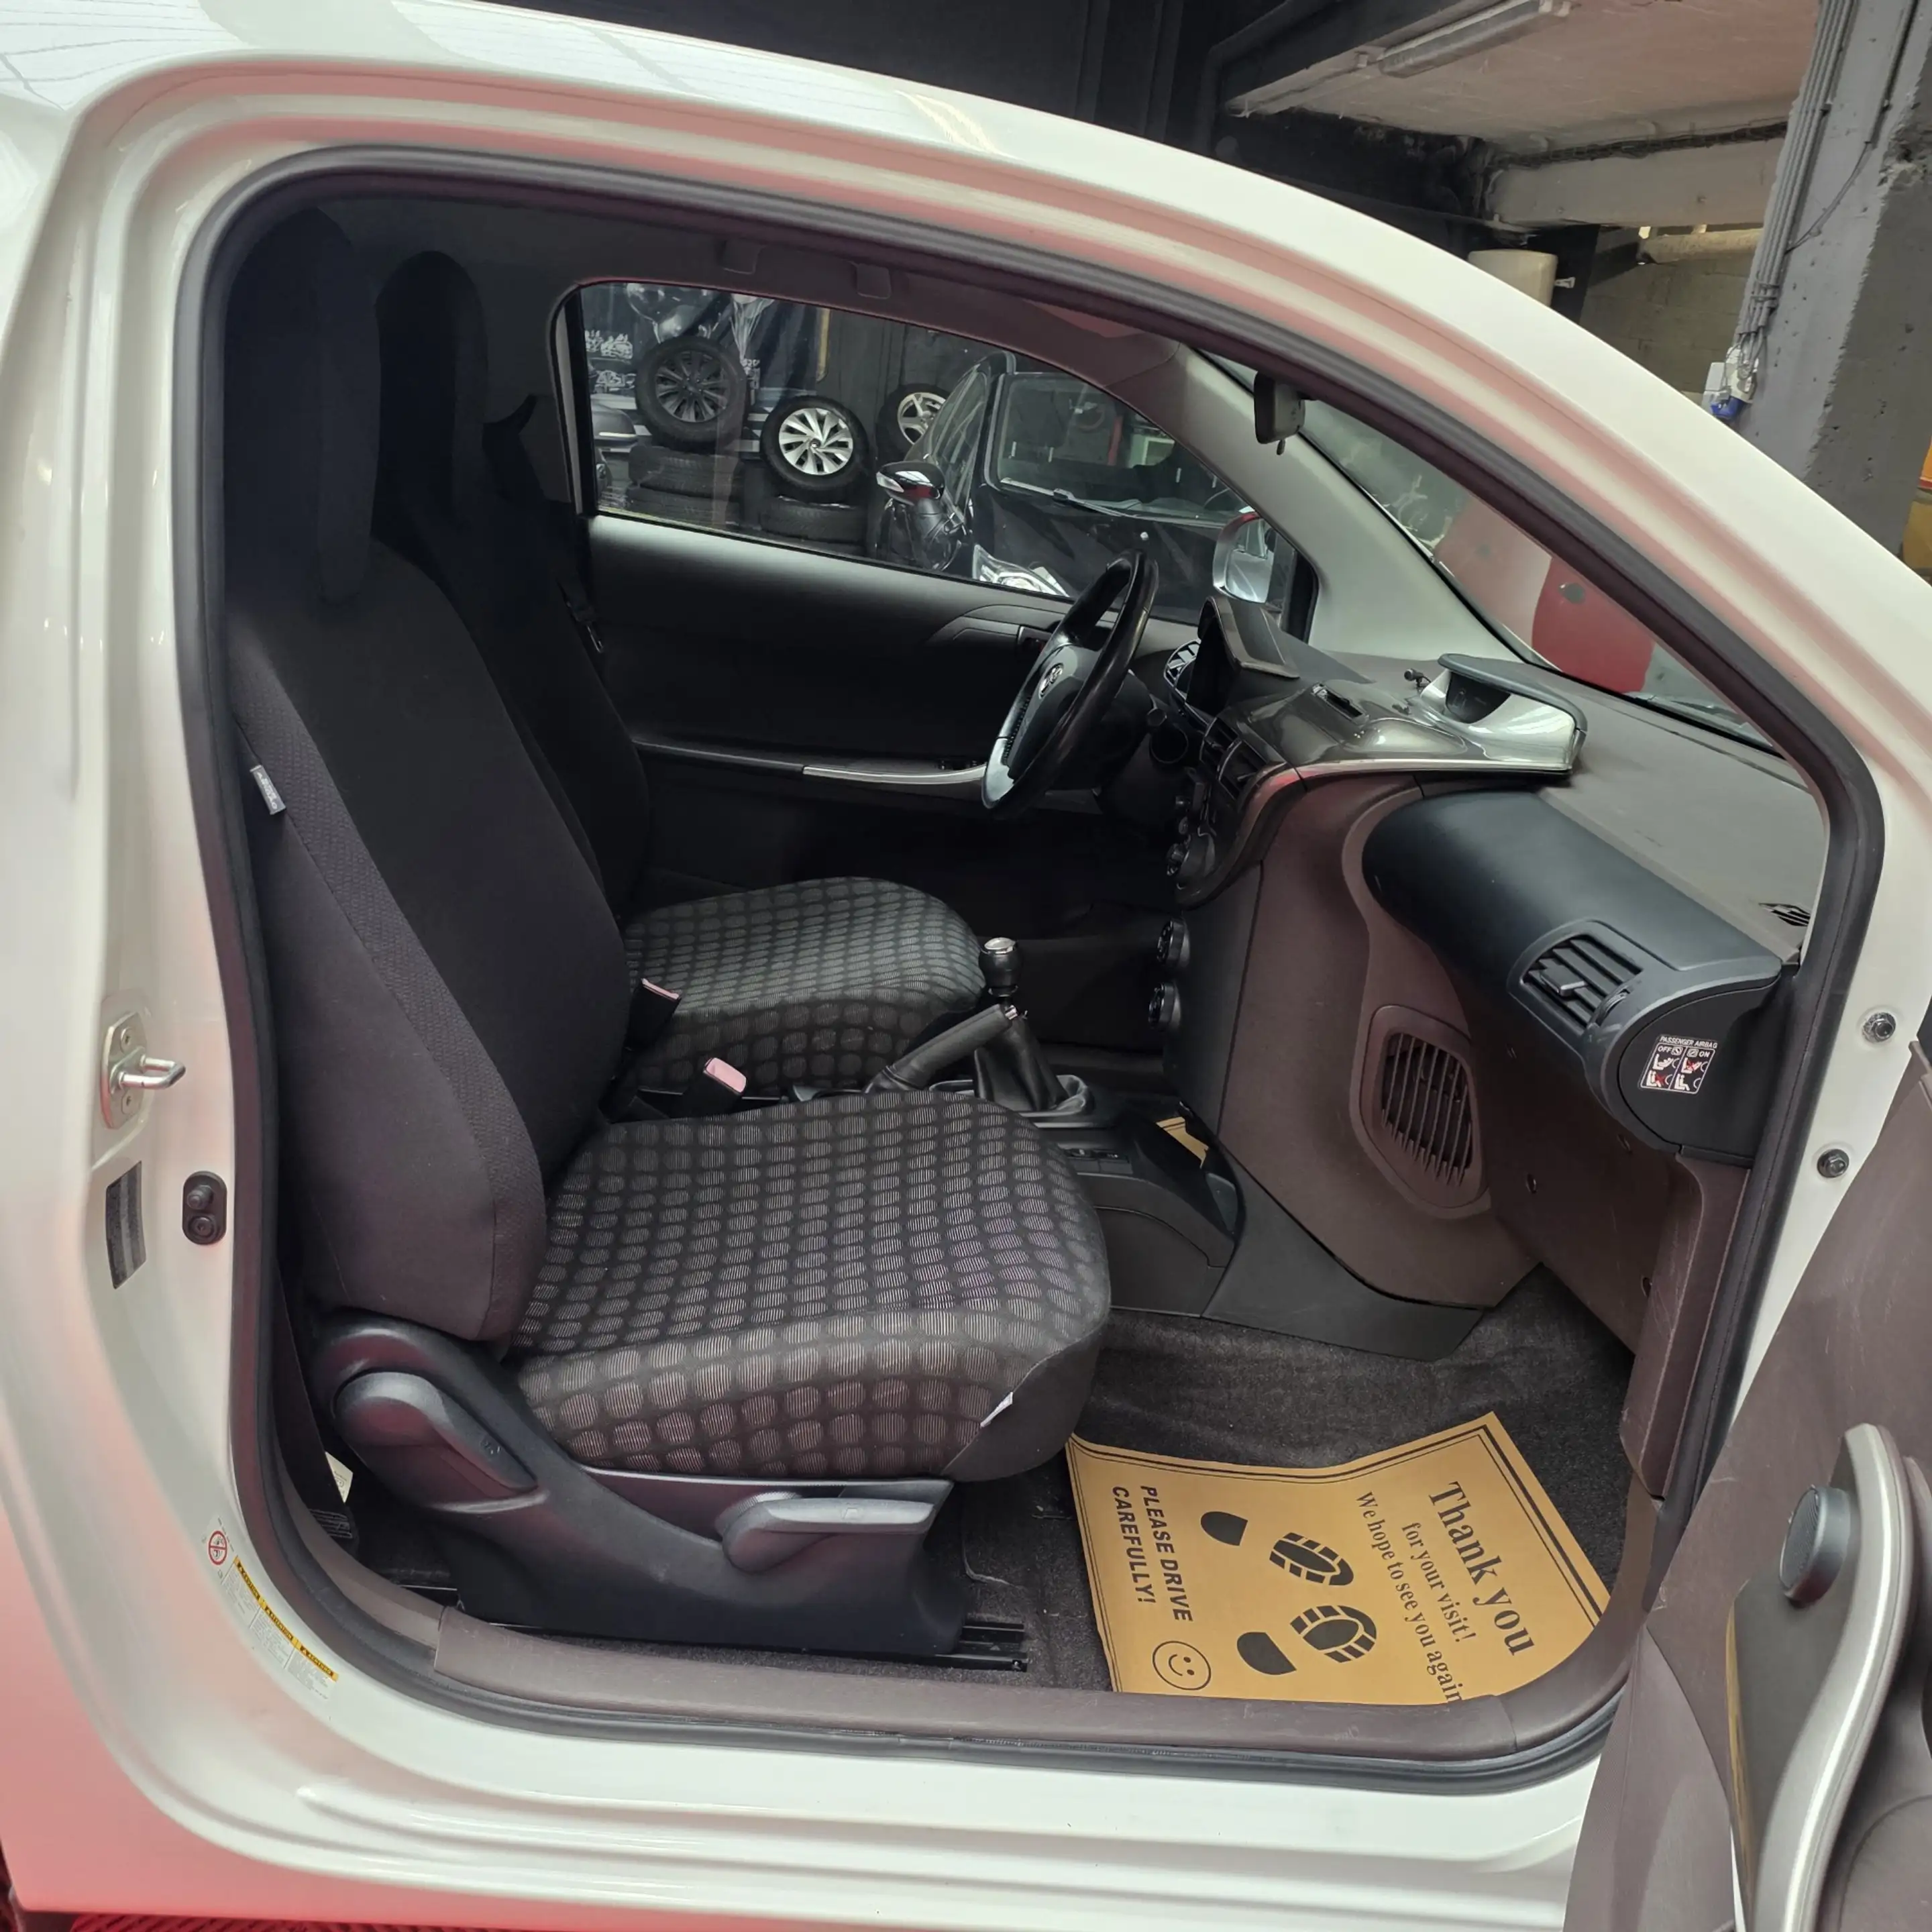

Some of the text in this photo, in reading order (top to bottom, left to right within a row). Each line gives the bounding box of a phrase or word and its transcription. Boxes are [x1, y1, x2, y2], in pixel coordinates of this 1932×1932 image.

[1660, 1036, 1718, 1049] PASSENGER AIRBAG
[1356, 1491, 1378, 1518] We
[1112, 1486, 1157, 1603] CAREFULLY!
[1140, 1485, 1193, 1621] PLEASE DRIVE
[1367, 1519, 1395, 1560] hope
[1387, 1562, 1404, 1580] to
[1401, 1522, 1477, 1642] for your visit!
[1429, 1481, 1535, 1656] Thank you
[1395, 1582, 1418, 1611] see
[1404, 1612, 1436, 1648] you
